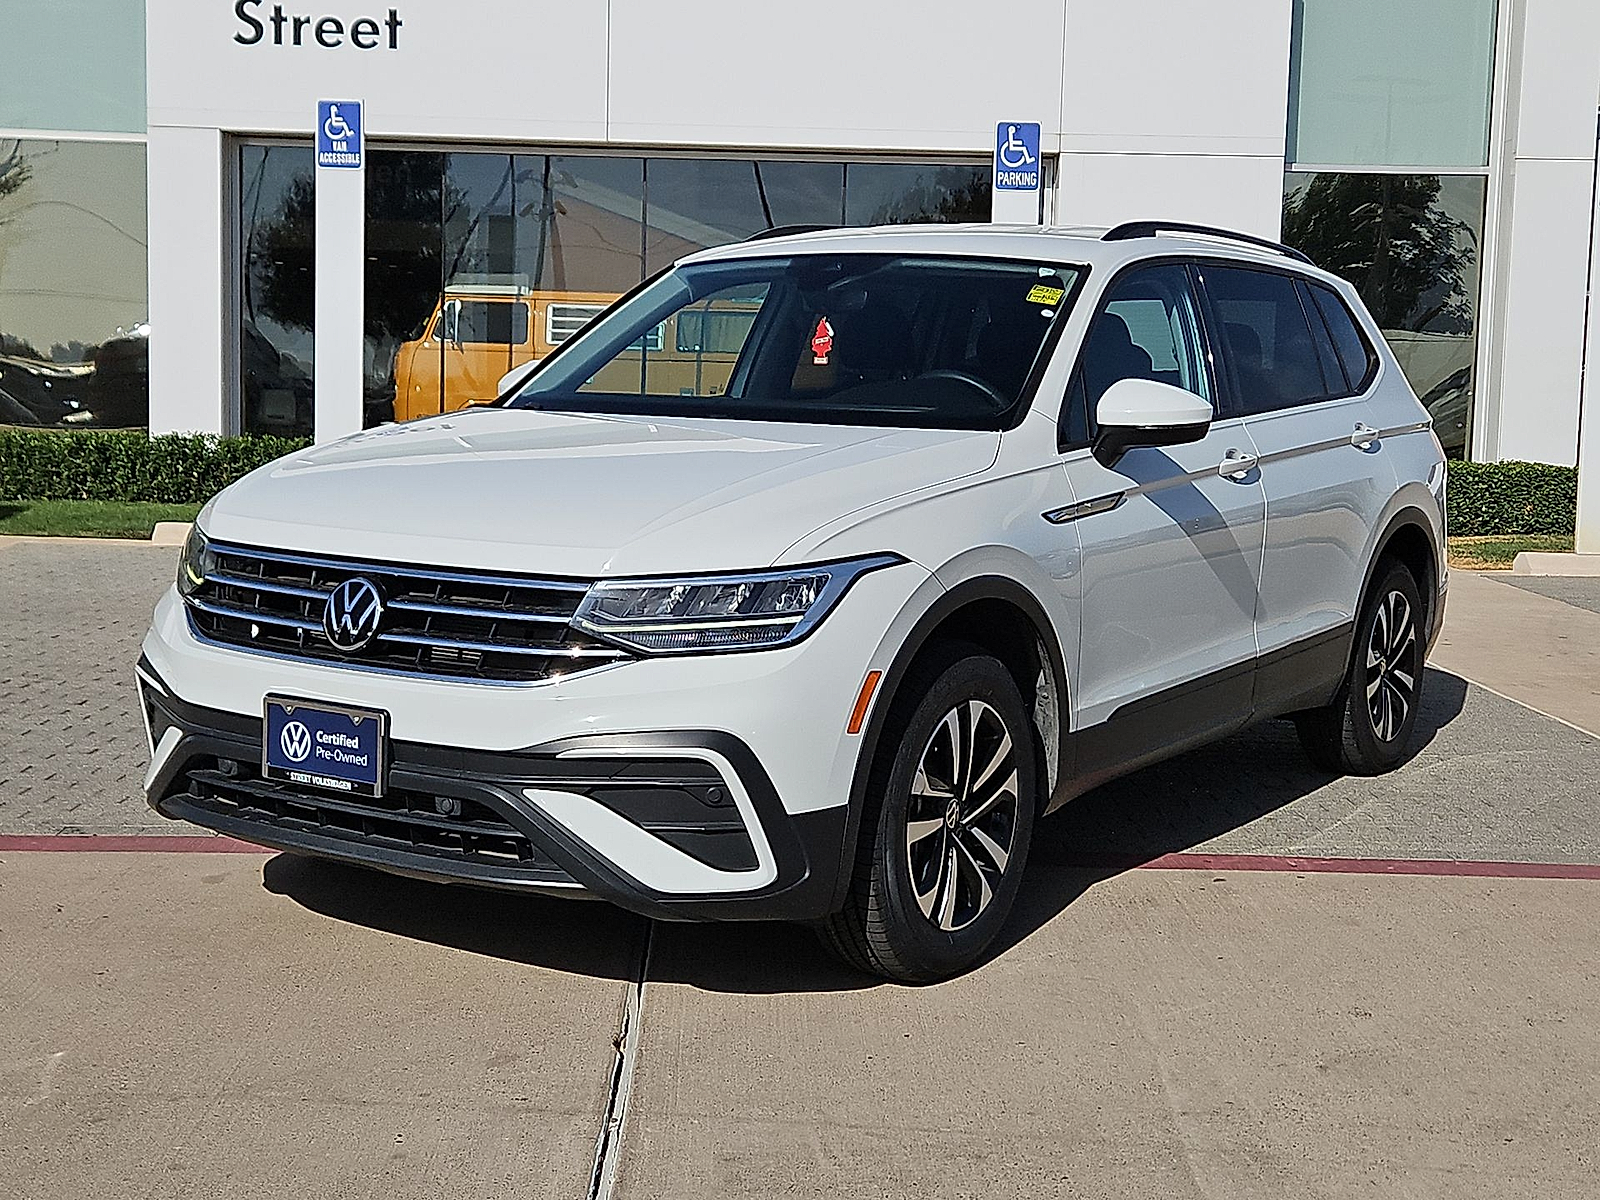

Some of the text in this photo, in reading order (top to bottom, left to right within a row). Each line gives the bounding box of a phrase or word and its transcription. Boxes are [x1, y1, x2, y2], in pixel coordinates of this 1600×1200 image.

[233, 0, 403, 49] Street
[319, 151, 360, 164] ACCESSIBLE
[997, 171, 1037, 187] PARKING
[316, 730, 359, 749] Certified
[316, 746, 368, 767] Pre-Owned
[290, 771, 312, 784] STREET
